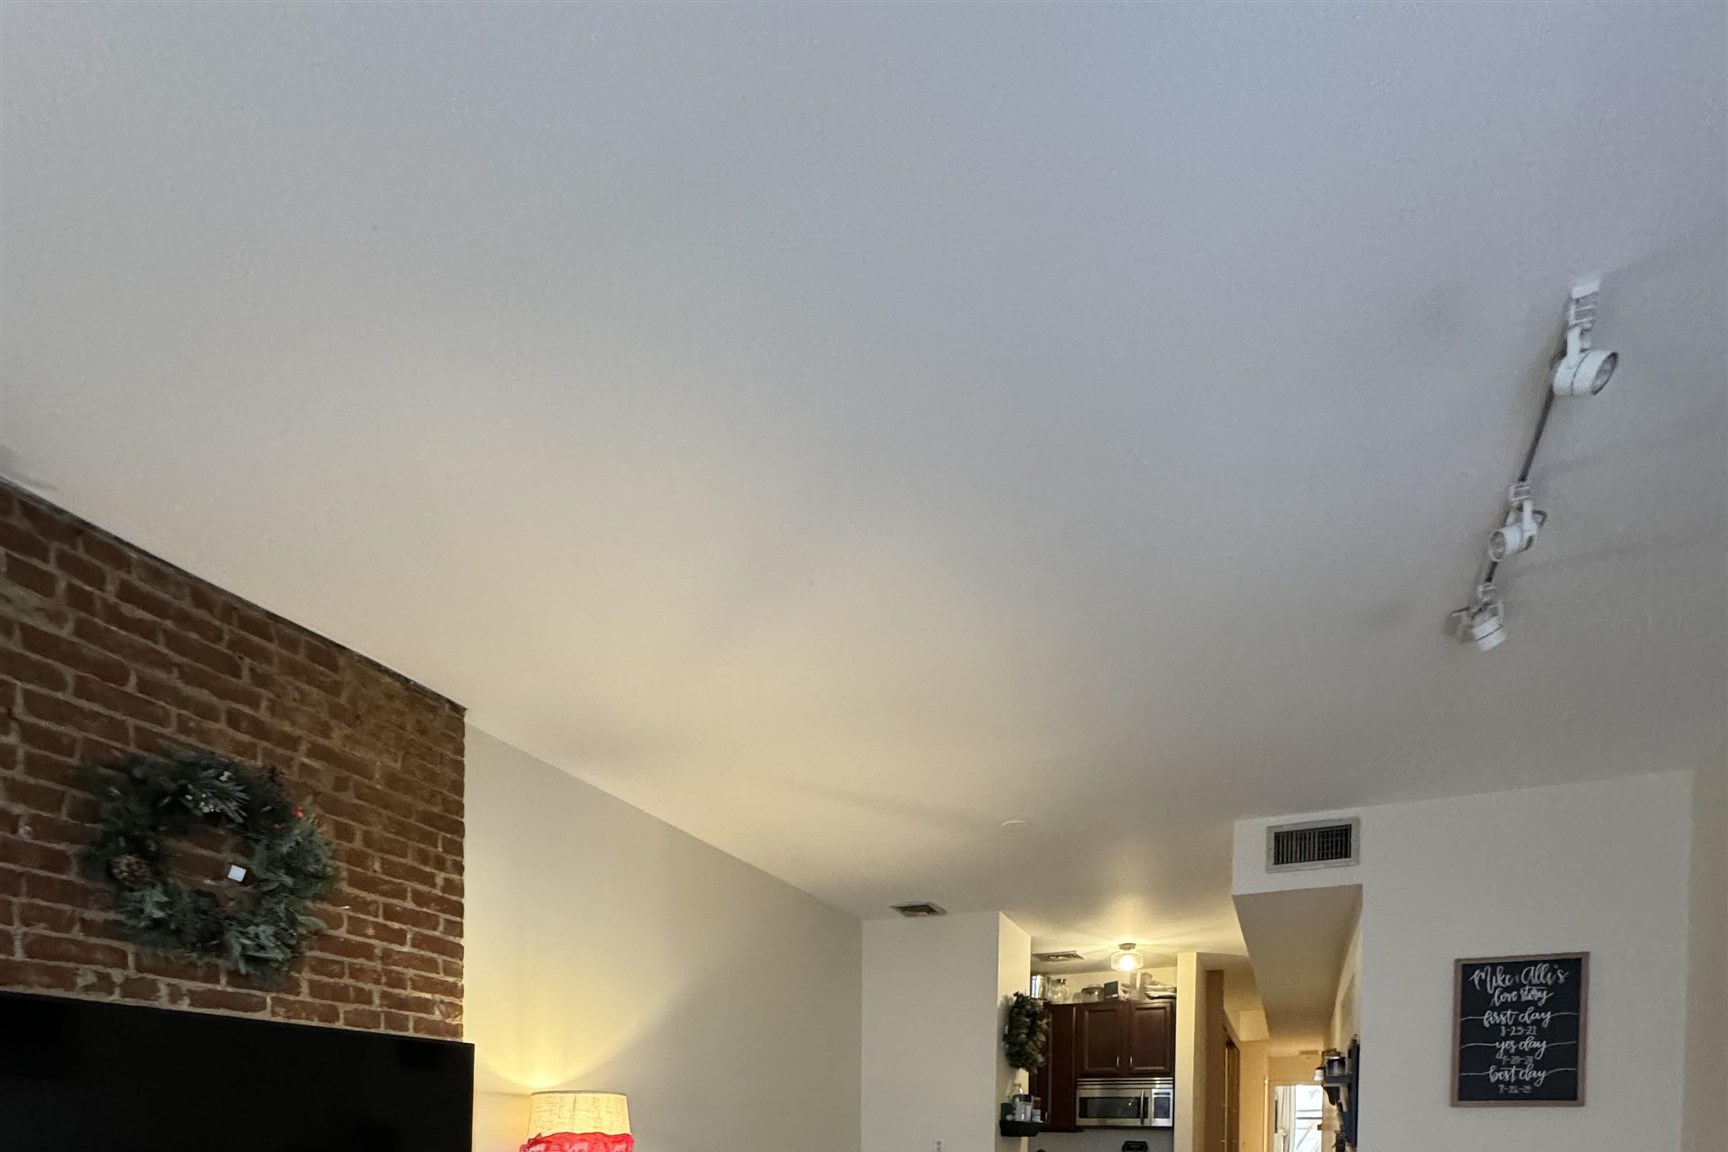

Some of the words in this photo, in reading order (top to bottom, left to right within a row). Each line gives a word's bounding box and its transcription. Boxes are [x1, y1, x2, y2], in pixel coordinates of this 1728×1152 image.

[1468, 966, 1513, 993] Mike
[1492, 989, 1518, 1006] love
[1482, 1009, 1518, 1028] first
[1518, 1006, 1551, 1027] day
[1495, 1042, 1518, 1059] yes
[1518, 1036, 1547, 1060] day
[1488, 1065, 1519, 1083] best
[1518, 1064, 1547, 1086] day
